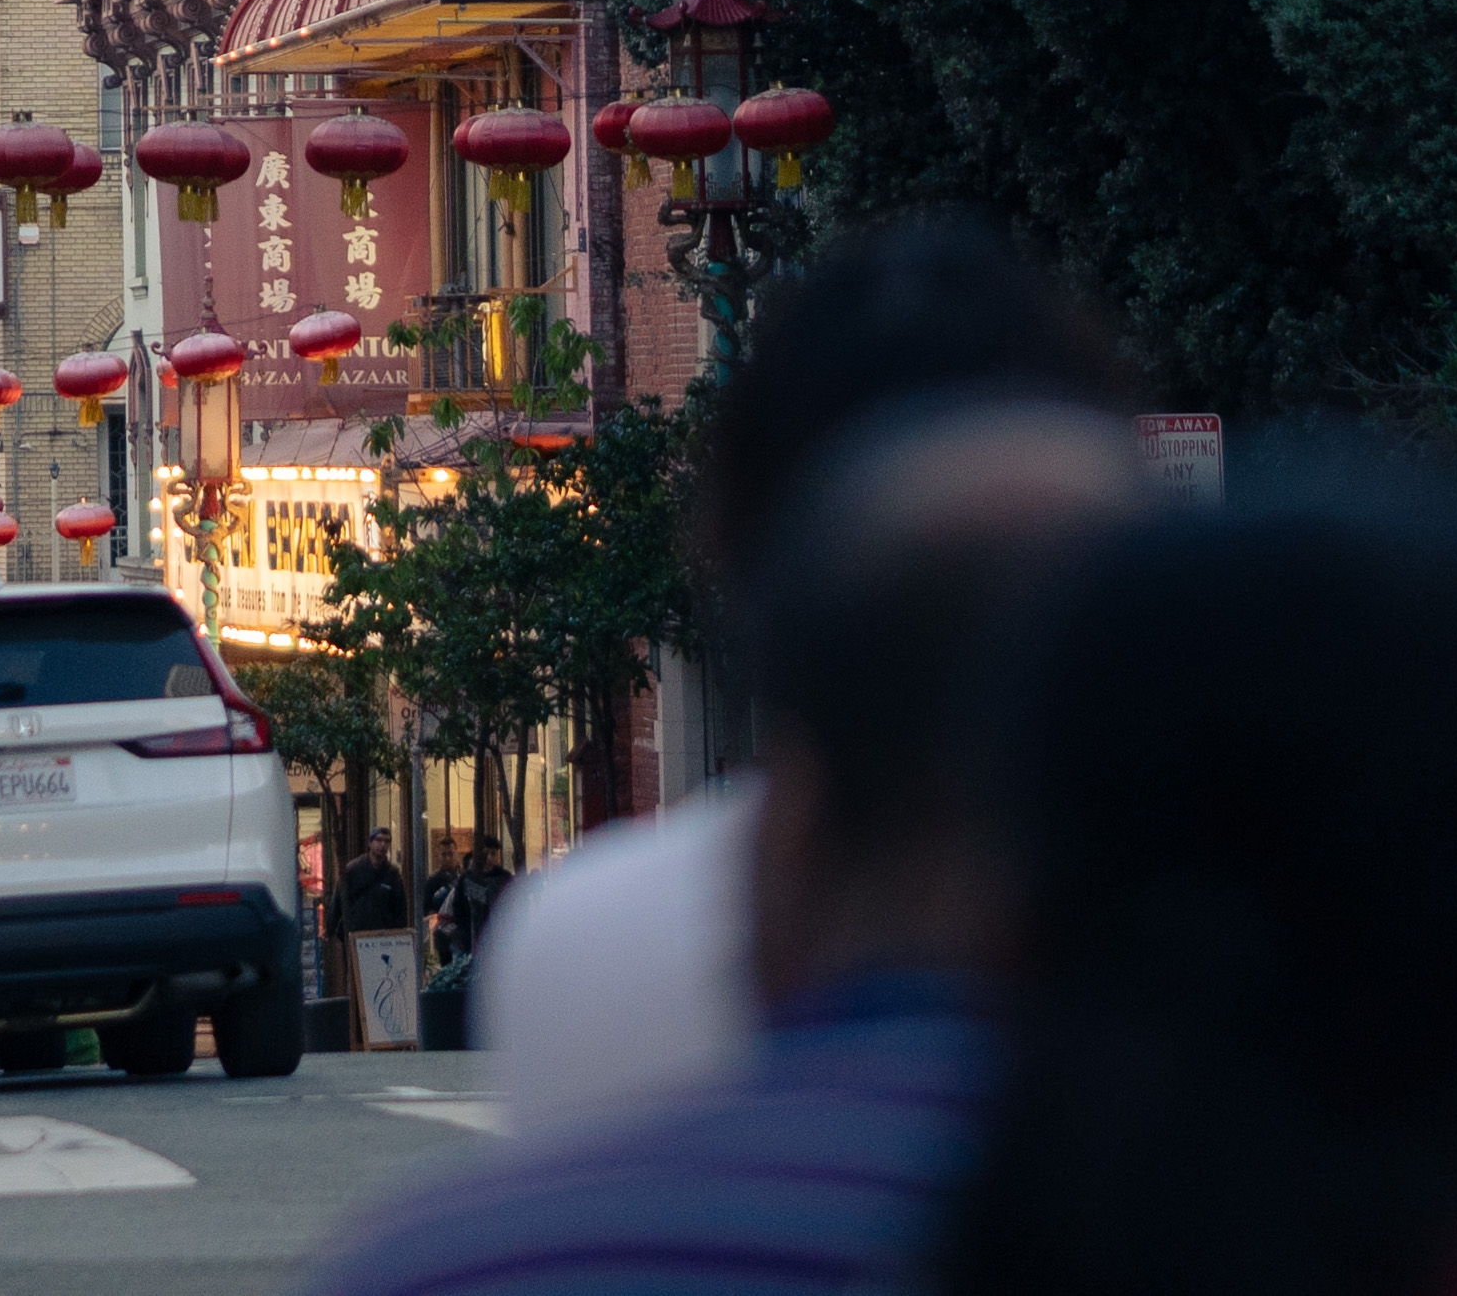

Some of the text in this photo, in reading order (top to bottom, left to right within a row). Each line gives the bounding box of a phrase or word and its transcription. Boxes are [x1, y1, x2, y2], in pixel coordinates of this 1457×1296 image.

[254, 151, 298, 313] 廣東商場
[342, 191, 383, 310] 商場
[240, 370, 302, 386] BAZAA
[337, 370, 409, 386] AZAAR
[1140, 418, 1214, 432] TOW-AWAY
[1160, 439, 1217, 458] STOPPING
[1163, 462, 1195, 480] ANY
[271, 580, 286, 613] from
